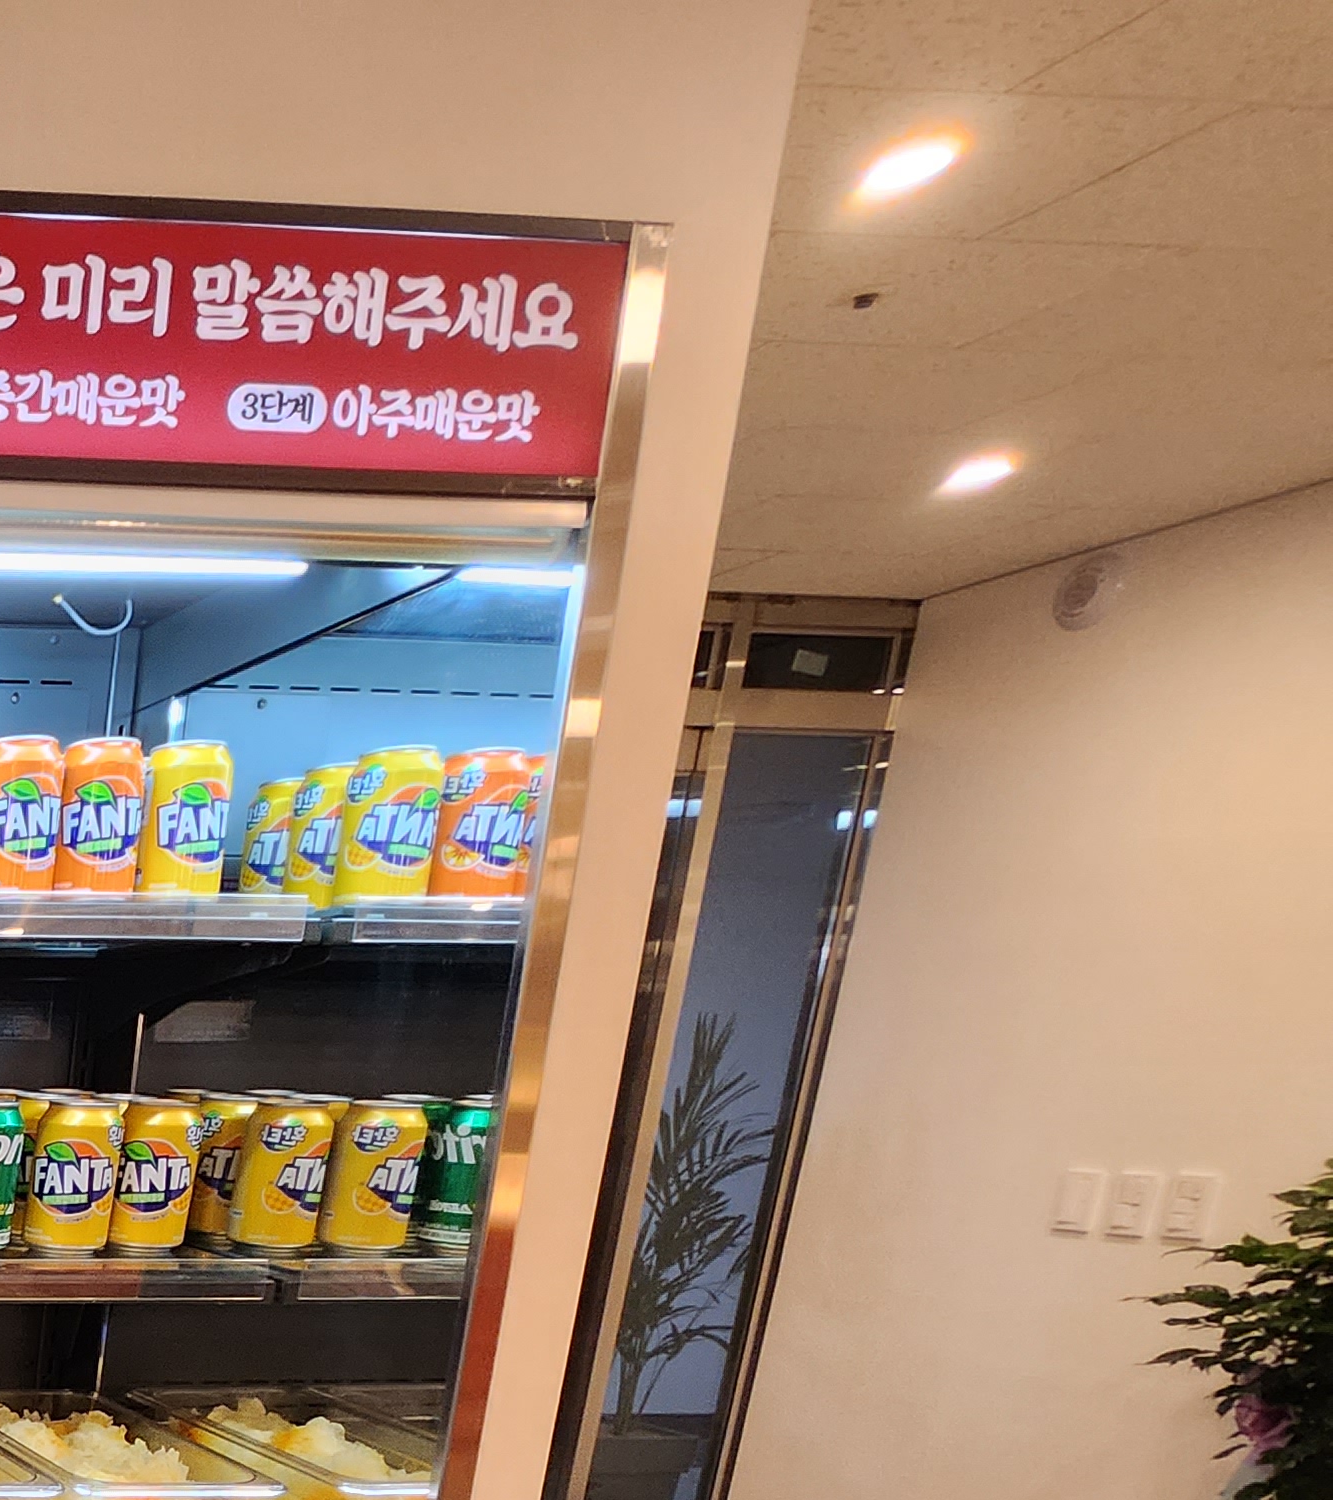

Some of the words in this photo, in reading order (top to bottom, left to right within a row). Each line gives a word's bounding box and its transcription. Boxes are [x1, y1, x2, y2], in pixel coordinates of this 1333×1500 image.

[41, 253, 169, 337] 미리
[193, 258, 579, 352] 말씀해주세요
[240, 390, 316, 425] 3단계
[332, 385, 540, 445] 아주매운맛
[34, 1155, 114, 1195] FANTA
